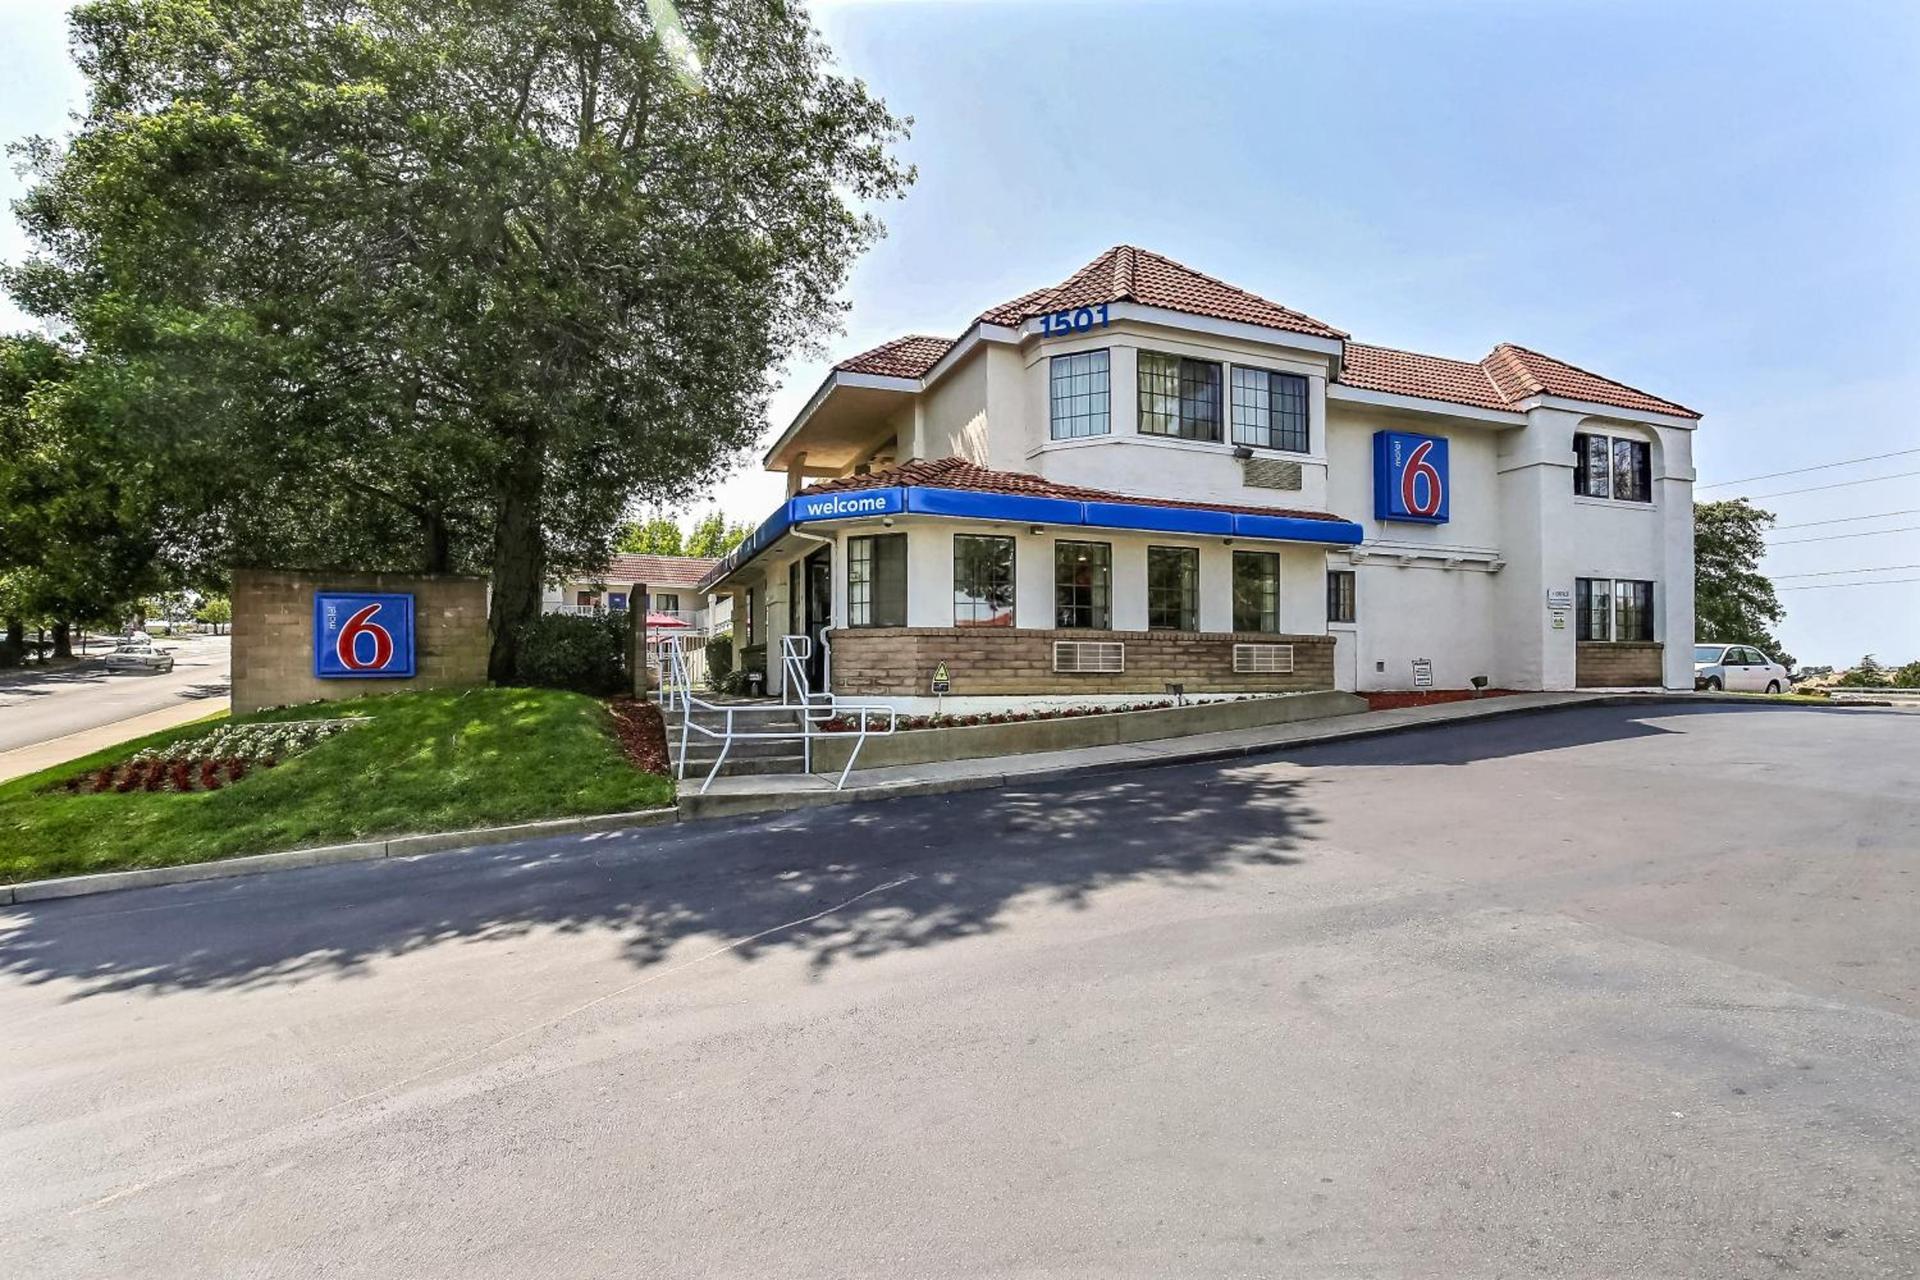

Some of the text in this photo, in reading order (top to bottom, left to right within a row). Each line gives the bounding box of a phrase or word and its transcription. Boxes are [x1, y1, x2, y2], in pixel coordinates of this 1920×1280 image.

[1040, 303, 1108, 338] 1501
[1401, 440, 1442, 517] 6
[807, 496, 886, 515] welcome
[328, 606, 336, 630] motel
[336, 603, 394, 670] 6
